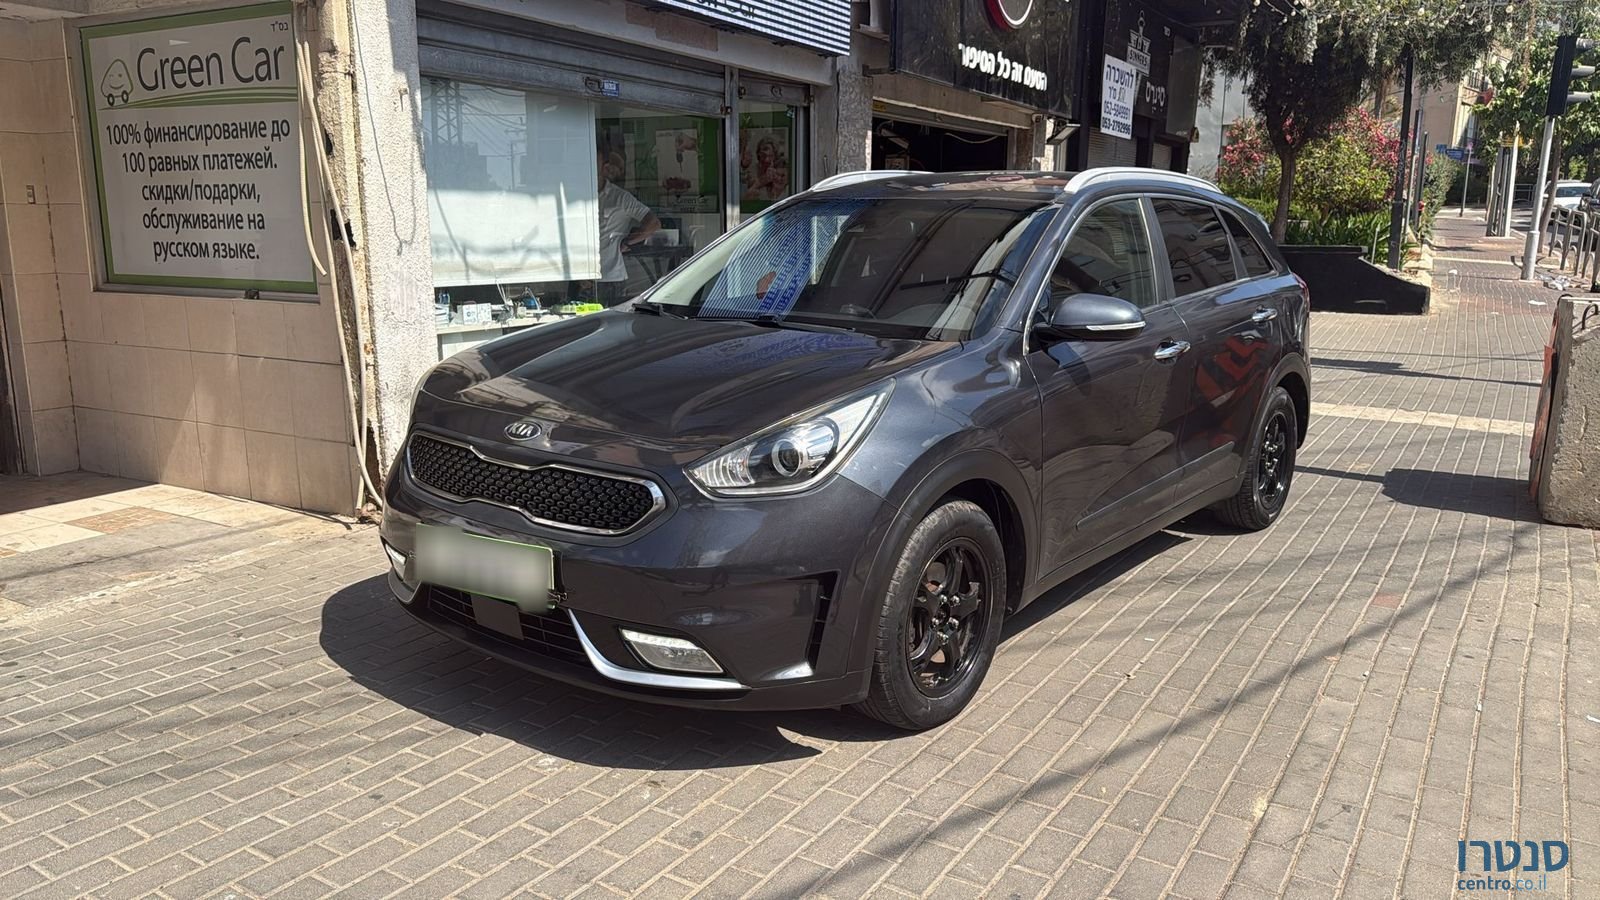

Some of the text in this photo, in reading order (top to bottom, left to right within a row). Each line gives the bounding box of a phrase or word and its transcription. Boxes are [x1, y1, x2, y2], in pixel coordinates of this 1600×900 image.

[136, 36, 285, 92] Green Car
[997, 50, 1011, 79] כל
[1105, 64, 1134, 89] להשכרה
[106, 118, 290, 148] 100% финансирование до
[122, 146, 278, 178] 100 равных платежей.
[141, 178, 261, 206] скидки/подарки,
[142, 206, 266, 235] обслуживание на
[153, 239, 260, 263] русском языке.
[508, 422, 535, 437] KIA
